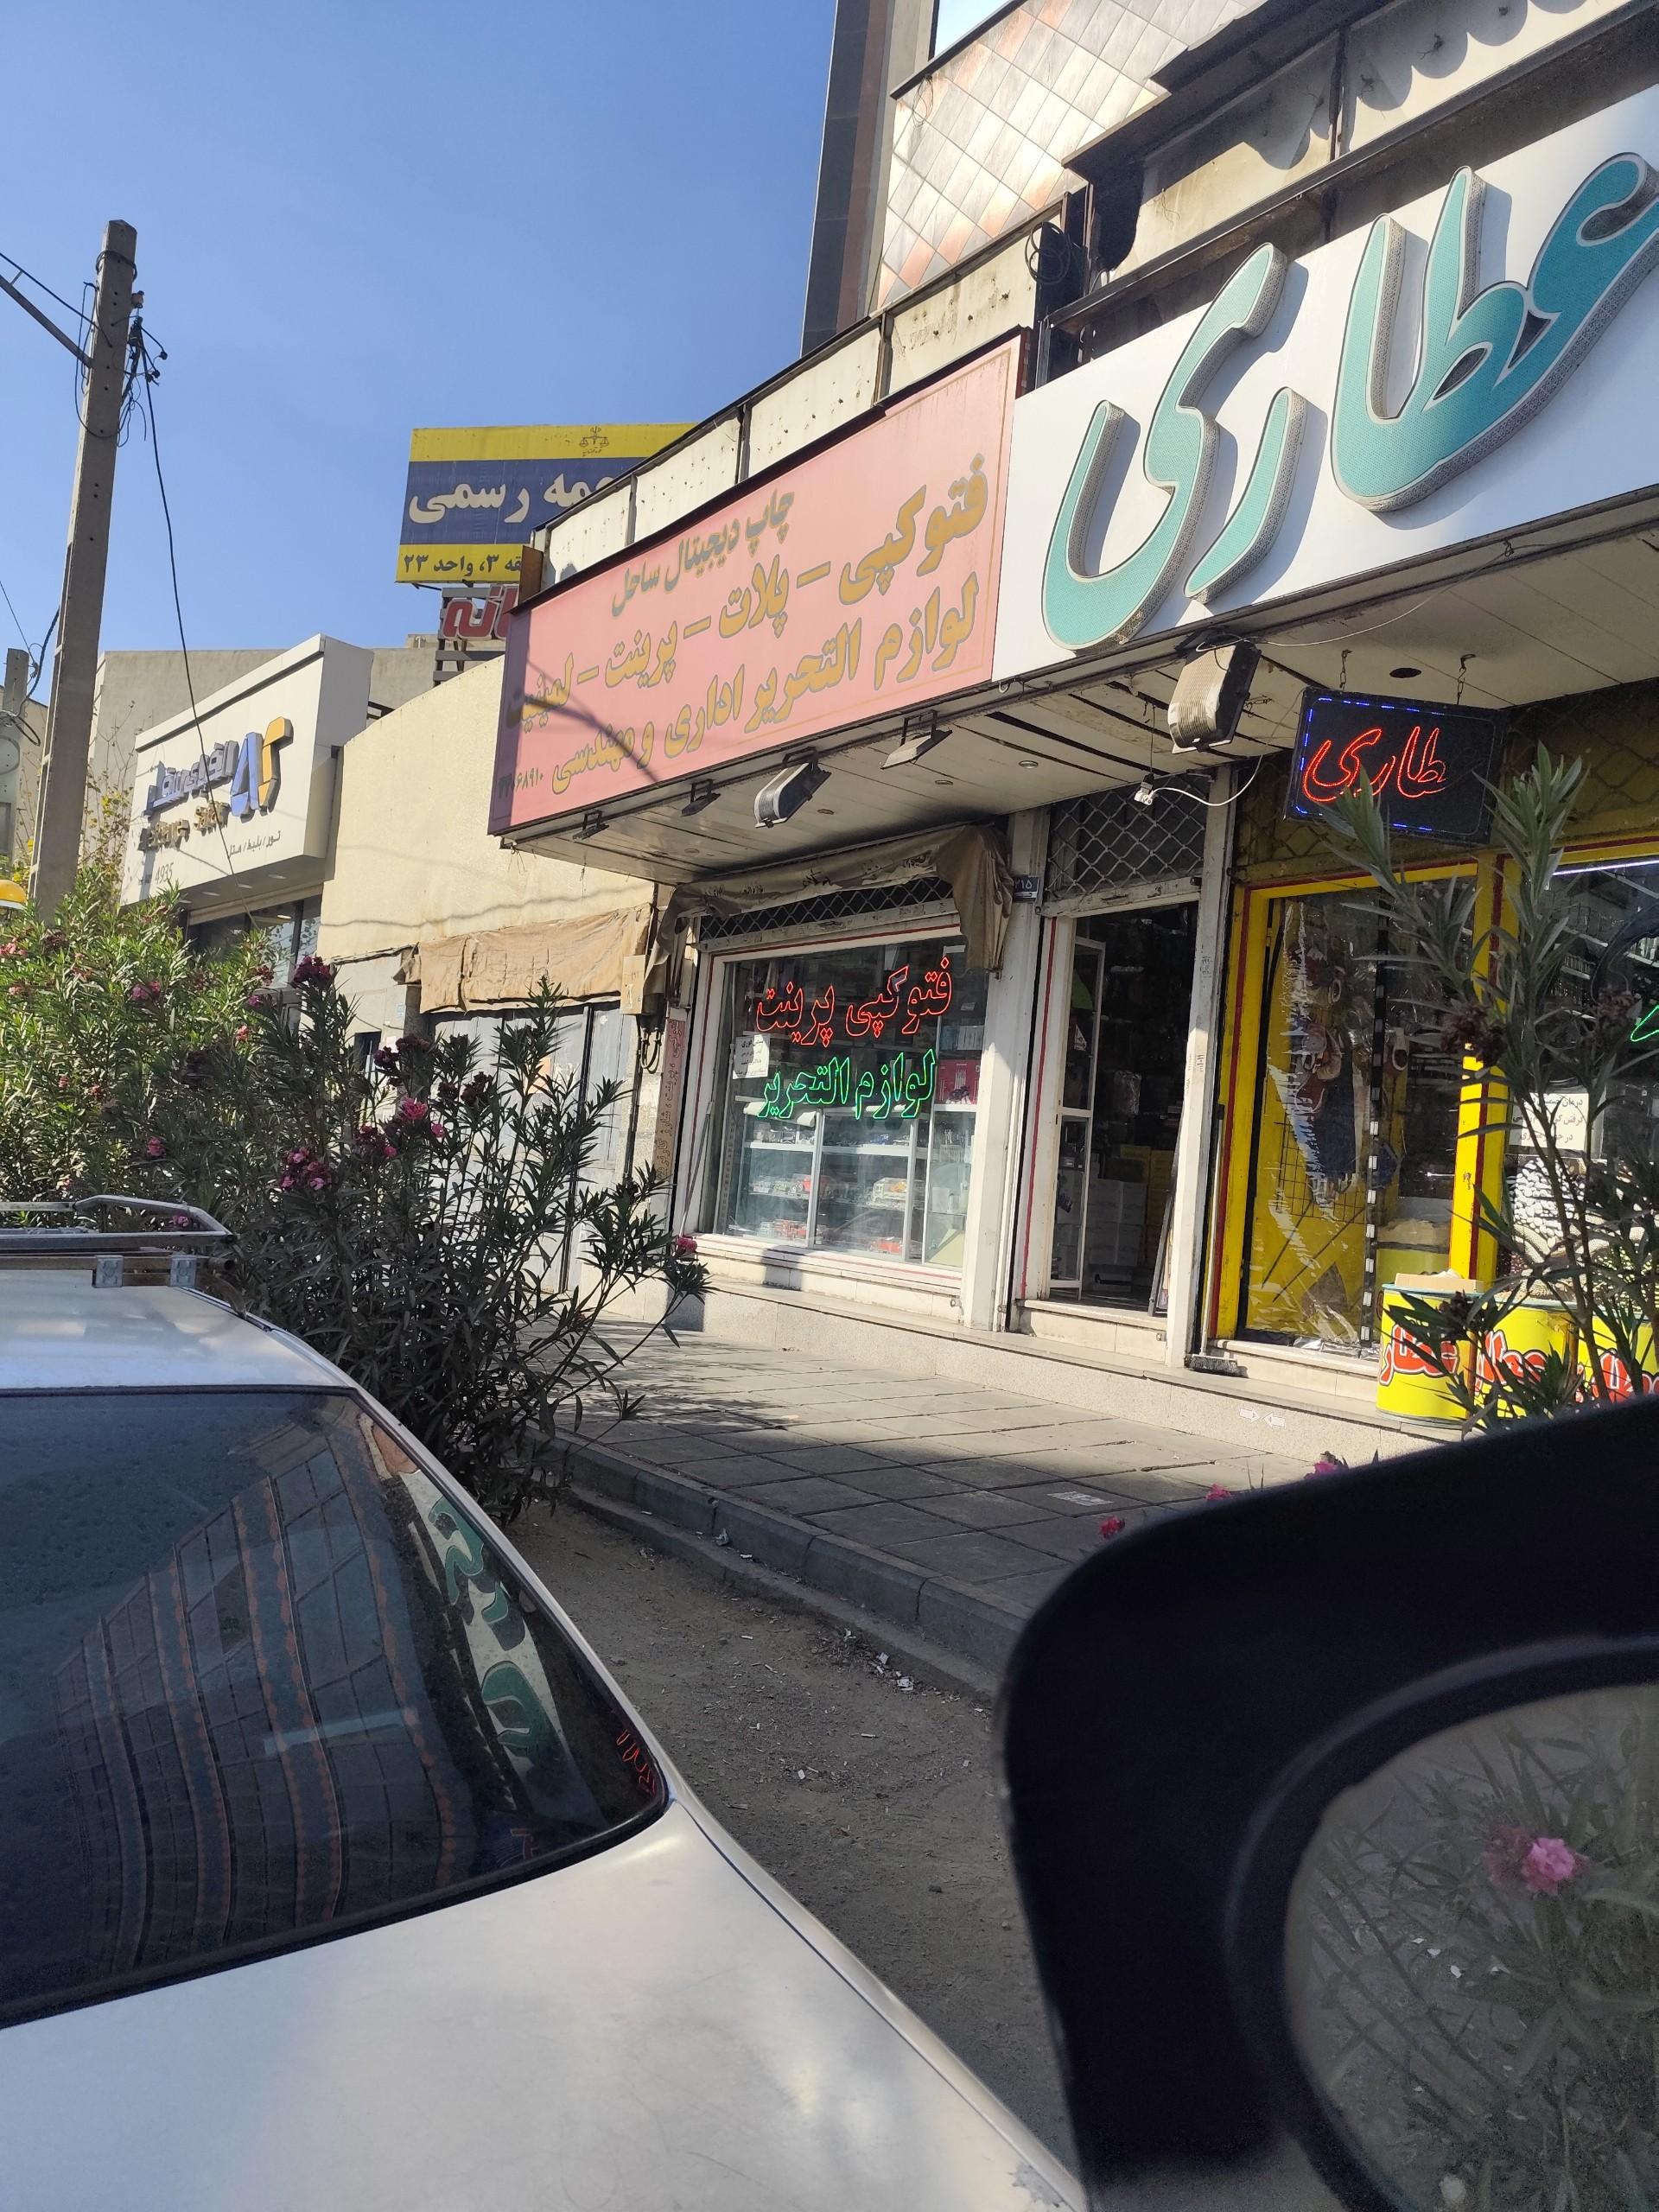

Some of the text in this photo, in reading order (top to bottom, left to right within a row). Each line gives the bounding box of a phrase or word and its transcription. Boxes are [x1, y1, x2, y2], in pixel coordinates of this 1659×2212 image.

[1040, 152, 1659, 652] عطاری
[408, 480, 530, 524] رسمی
[745, 488, 795, 556] چاپ
[838, 454, 988, 606] فتوکپی
[404, 553, 429, 574] ۲۳
[433, 555, 474, 577] واحد
[664, 518, 740, 594] دیجیتال
[718, 554, 790, 638] پلات
[551, 570, 979, 796] لوازم التحریر اداری و مهندسی
[604, 620, 677, 689] پرینت
[1303, 725, 1447, 803] طاری
[756, 955, 952, 1048] فتوکپی پرینت
[757, 1048, 936, 1121] لوازم التحریر
